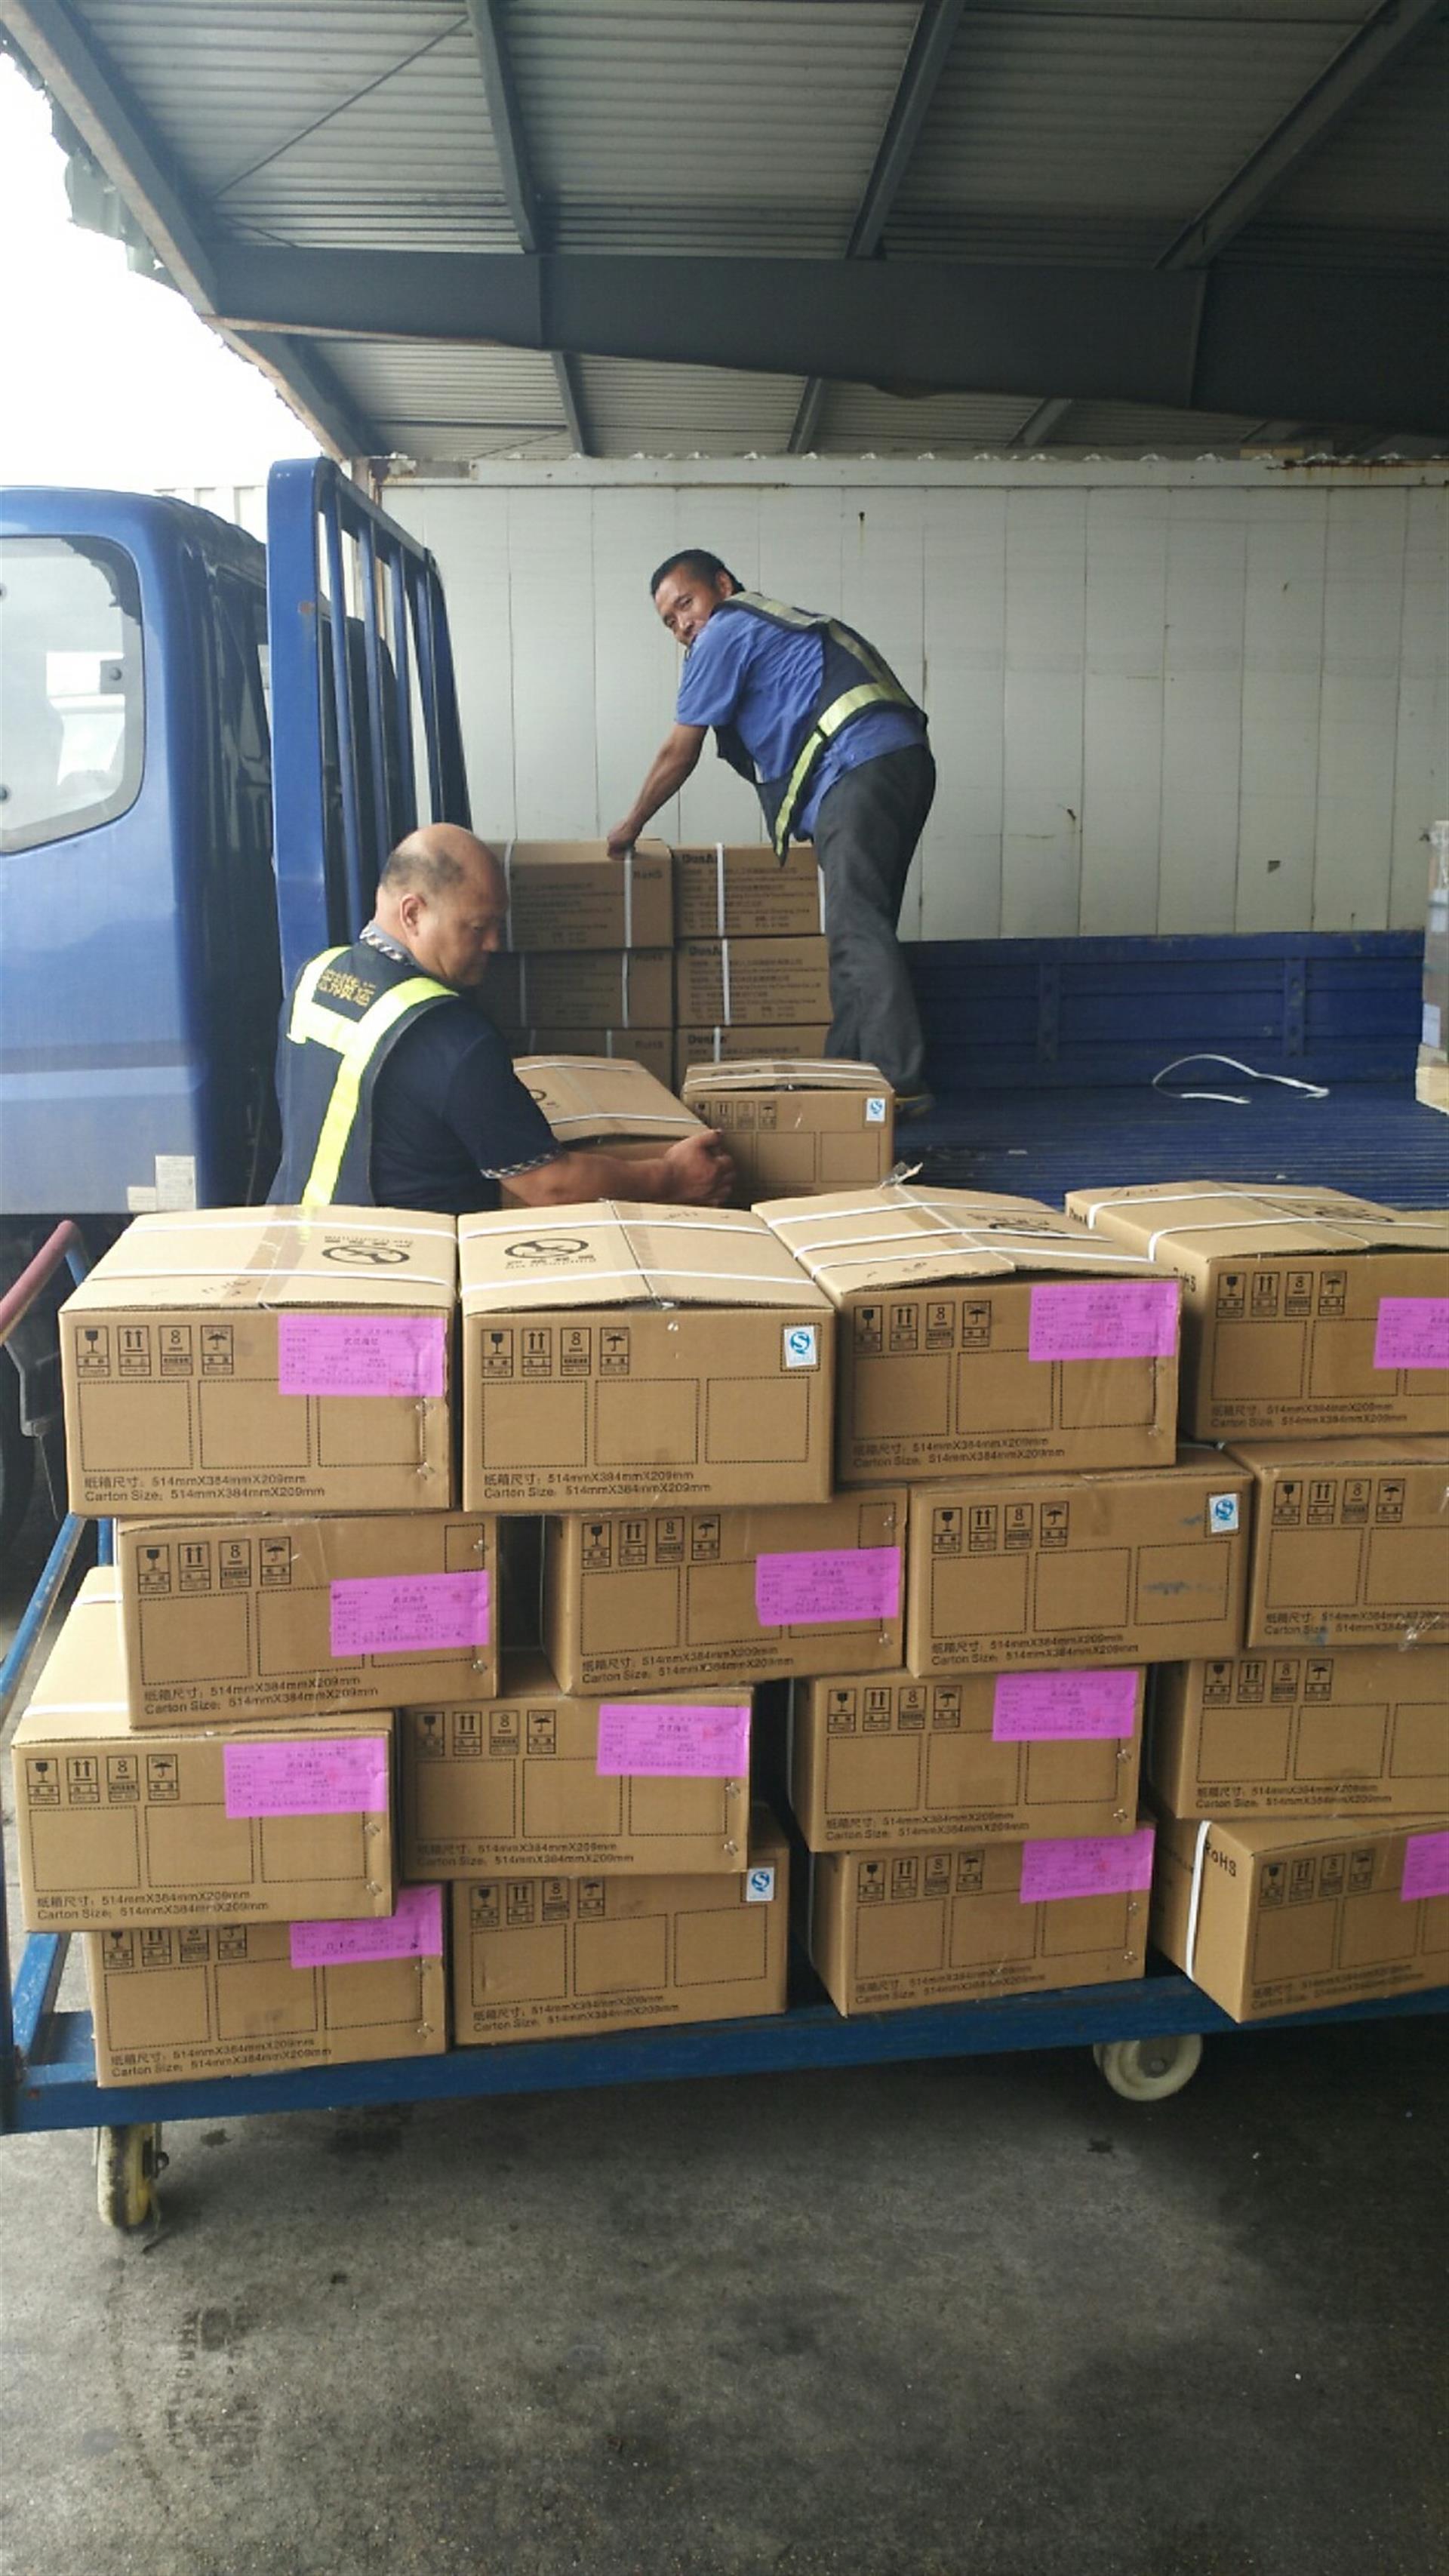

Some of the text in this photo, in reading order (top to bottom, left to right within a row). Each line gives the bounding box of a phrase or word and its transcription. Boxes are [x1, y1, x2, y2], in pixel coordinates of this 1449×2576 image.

[85, 1491, 128, 1502] Carton
[485, 1488, 525, 1499] Carton
[145, 1703, 186, 1715] Carton
[37, 1910, 78, 1921] Carton
